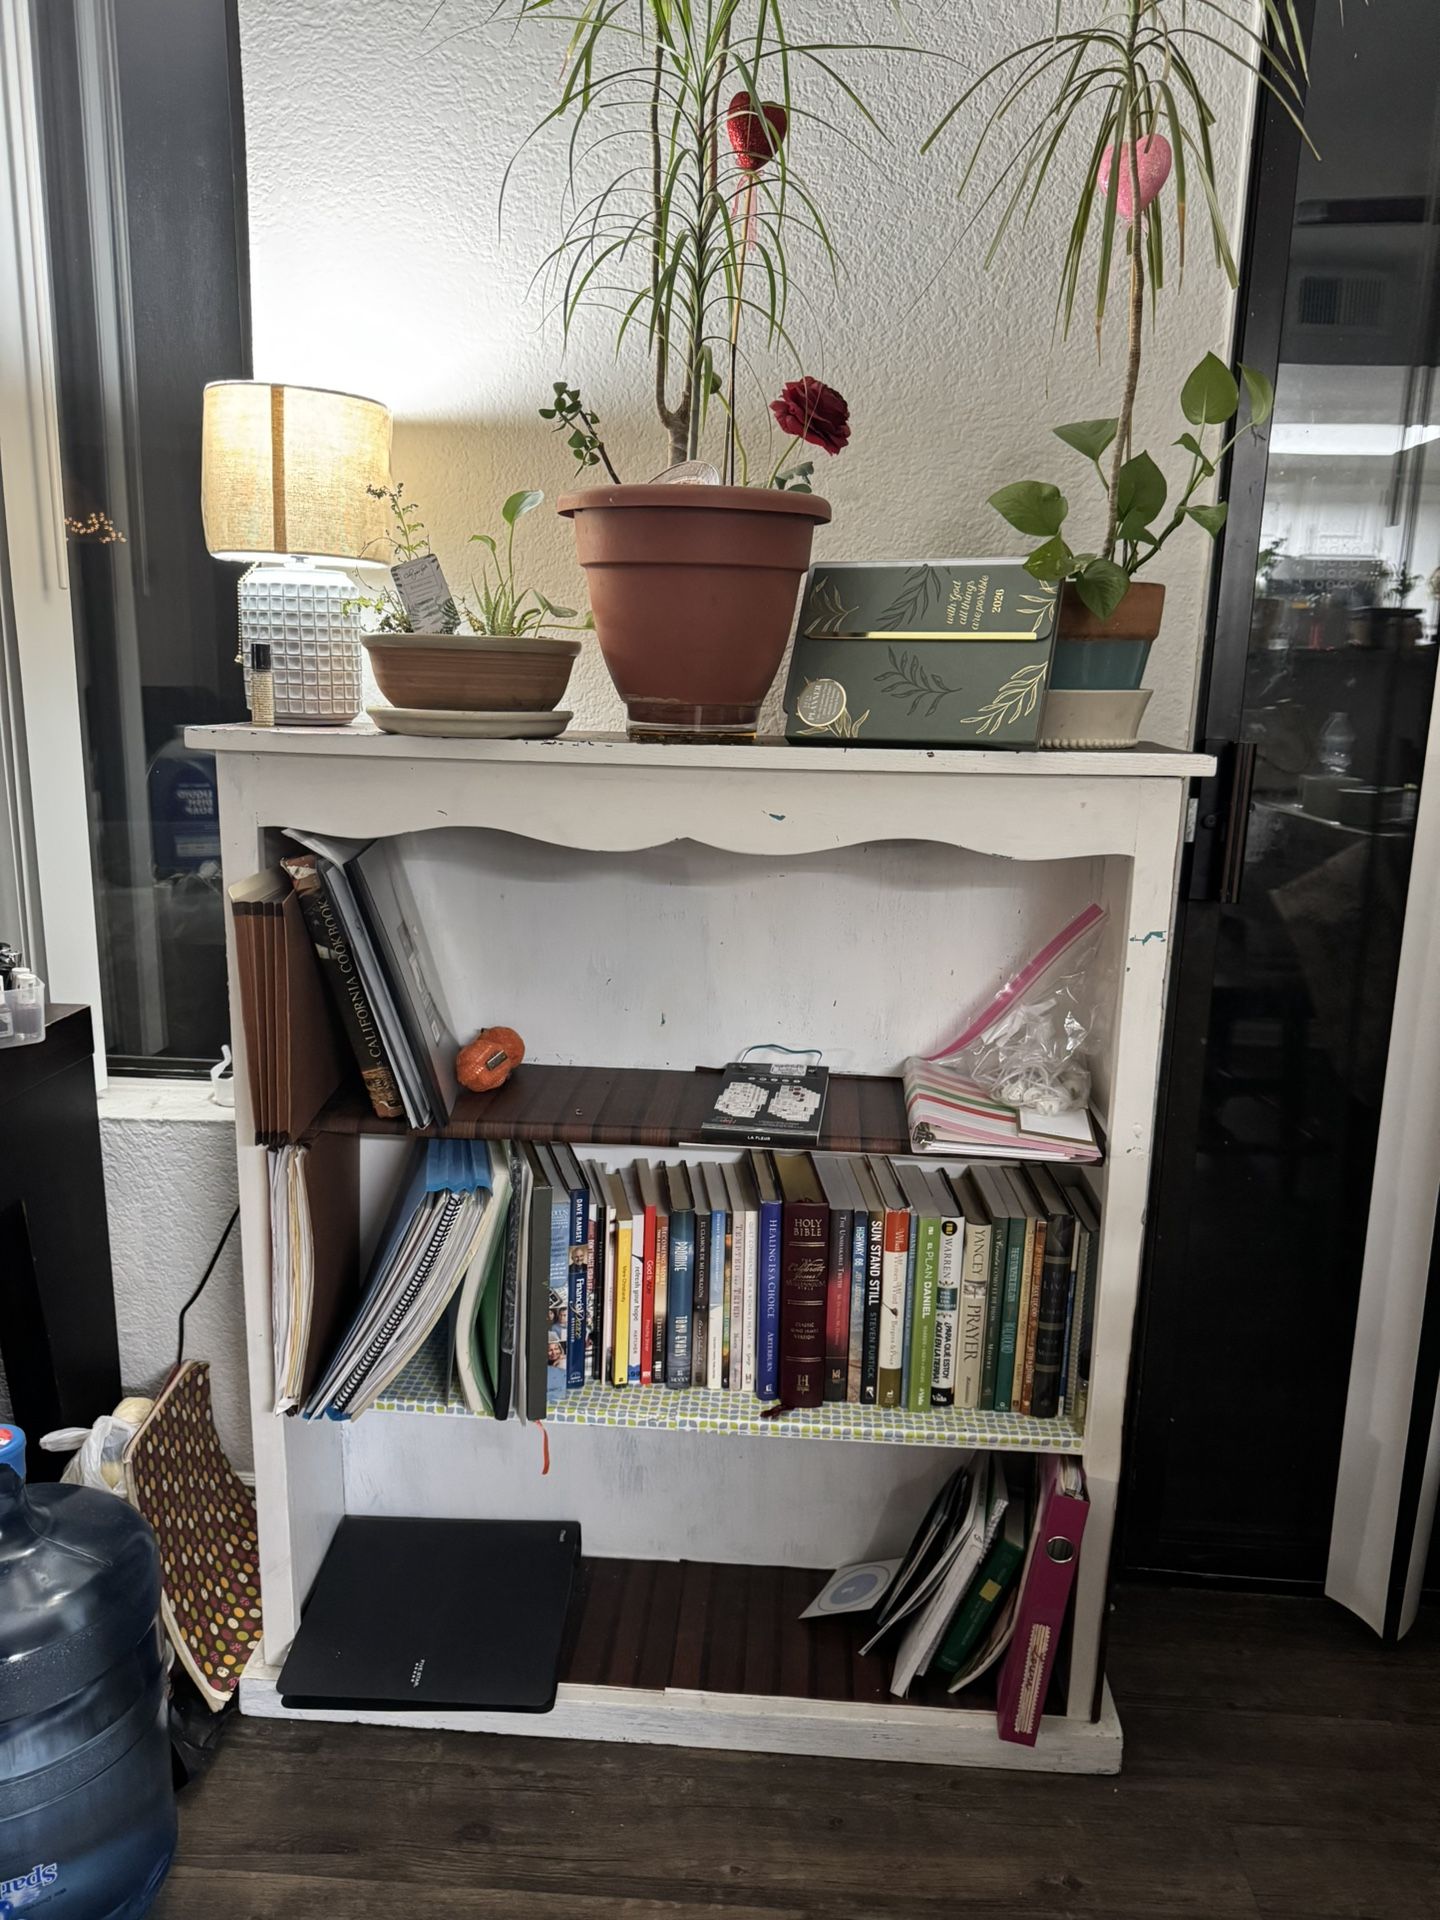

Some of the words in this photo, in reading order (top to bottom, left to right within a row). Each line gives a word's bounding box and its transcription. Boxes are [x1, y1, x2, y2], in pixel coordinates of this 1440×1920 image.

[948, 580, 962, 602] God
[960, 580, 976, 610] things
[976, 575, 989, 612] possible
[992, 588, 1004, 613] 2026
[946, 602, 957, 624] with
[959, 611, 968, 625] all
[971, 612, 982, 630] are
[808, 684, 822, 721] PLANNER
[318, 899, 354, 973] COOKBOOK
[346, 977, 382, 1059] CALIFORNIA
[794, 1218, 822, 1228] HOLY
[794, 1228, 822, 1236] BIBLE
[871, 1220, 882, 1241] SUN
[768, 1219, 778, 1262] HEALING
[855, 1226, 865, 1256] HIGHWAY
[894, 1228, 904, 1252] What
[927, 1242, 934, 1250] EL
[674, 1241, 688, 1272] PROMISE
[854, 1258, 864, 1266] 66
[870, 1244, 881, 1276] STAND
[943, 1238, 952, 1278] WARREN
[972, 1230, 986, 1276] YANCEY
[634, 1266, 642, 1289] refresh
[768, 1264, 777, 1273] IS
[893, 1254, 904, 1282] Women
[924, 1252, 934, 1279] PLAN
[576, 1278, 584, 1312] Financial
[733, 1288, 742, 1318] TRIED
[768, 1282, 777, 1318] CHOICE
[868, 1280, 880, 1306] STILL
[892, 1282, 902, 1304] Want
[922, 1282, 932, 1318] DANIEL
[632, 1304, 640, 1321] hope
[675, 1315, 688, 1332] TONY
[868, 1312, 876, 1343] STEVEN
[890, 1320, 898, 1344] Bergren
[944, 1322, 952, 1342] ¿PARA
[963, 1305, 982, 1363] PRAYER
[674, 1335, 688, 1357] EVANS
[766, 1332, 776, 1372] ARTERBURN
[934, 1348, 940, 1358] LA
[935, 1338, 941, 1348] EN
[944, 1343, 952, 1358] QUÉ
[867, 1344, 876, 1379] FURTICK
[942, 1358, 950, 1379] ESTOY
[986, 1344, 994, 1369] MOORE
[417, 1659, 426, 1672] FIVE
[413, 1672, 422, 1688] STAR
